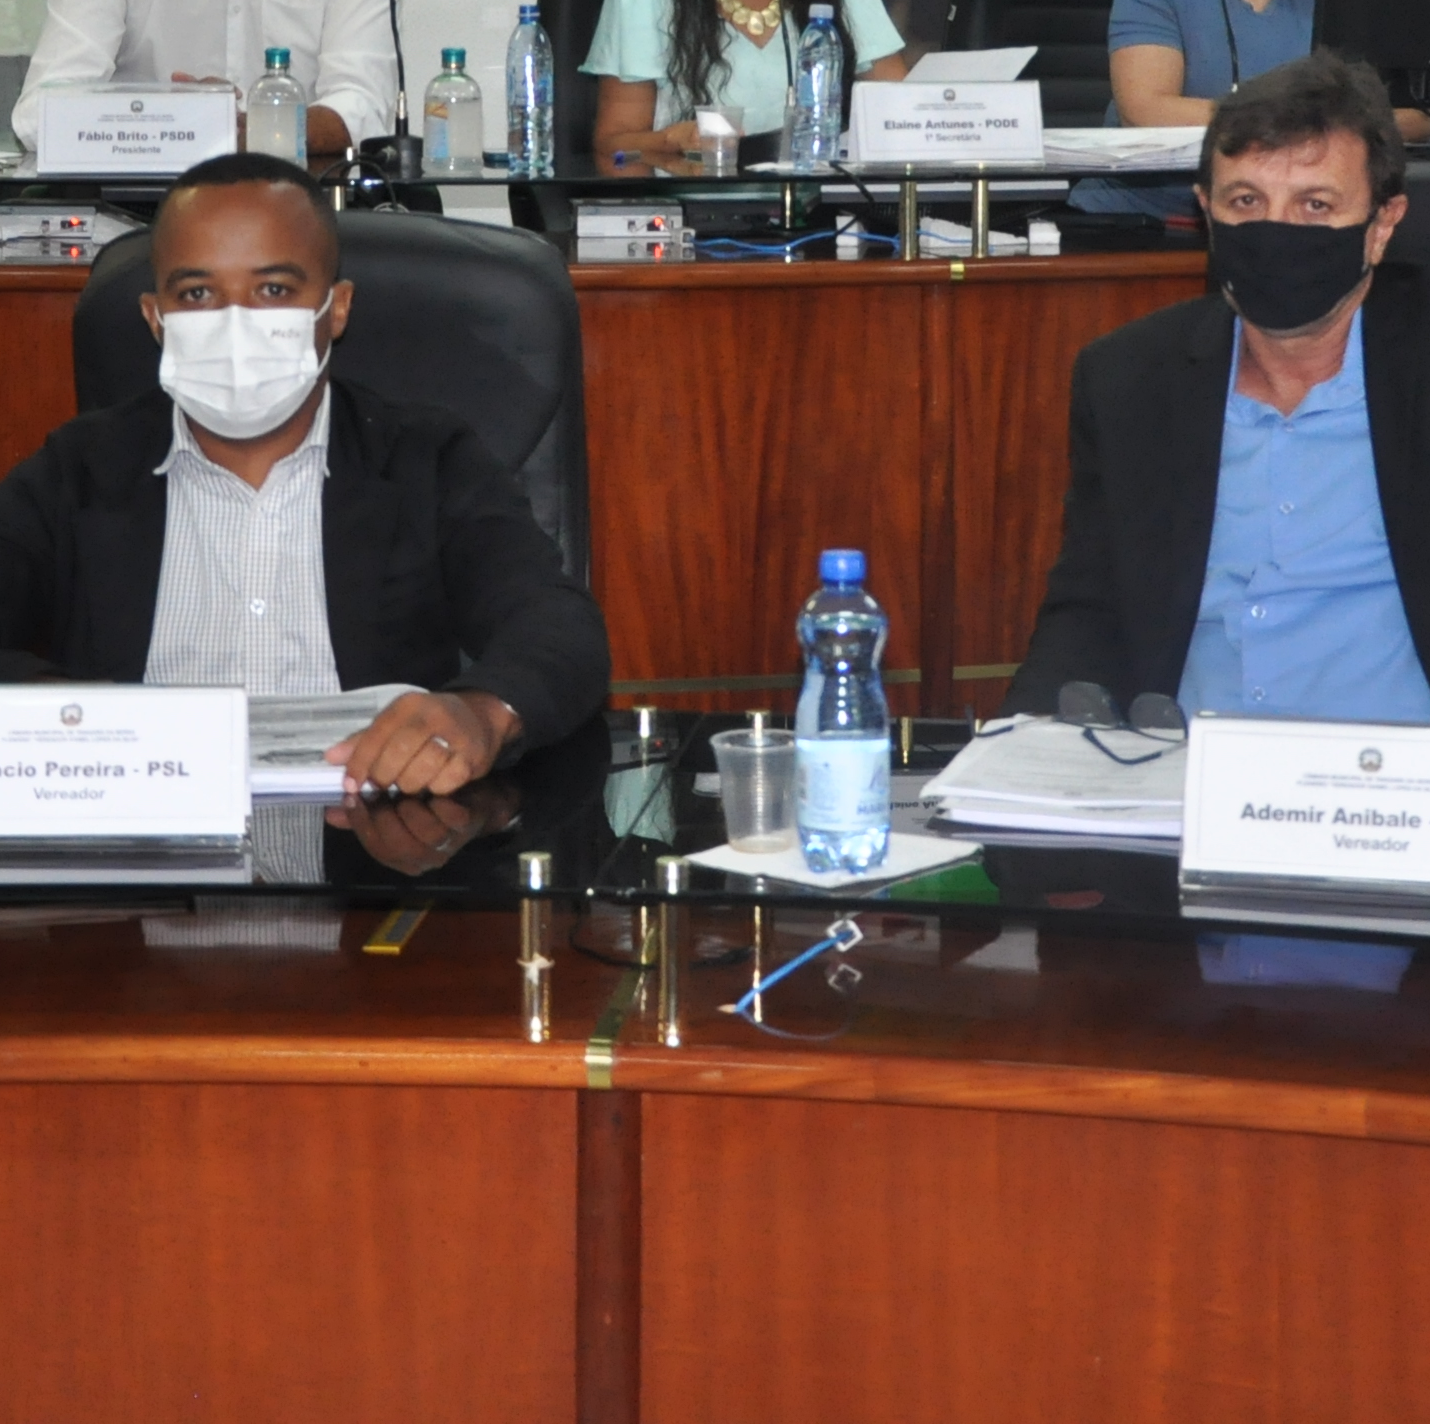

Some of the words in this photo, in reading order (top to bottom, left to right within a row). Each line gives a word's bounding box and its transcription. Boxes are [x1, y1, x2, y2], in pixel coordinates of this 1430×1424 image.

[884, 120, 921, 130] Elaine
[925, 120, 974, 130] Antunes
[985, 119, 1019, 129] PODE
[78, 130, 113, 141] Fábio
[117, 131, 148, 141] Brito
[160, 131, 196, 141] PSDB
[112, 145, 161, 155] Presidente
[45, 761, 125, 778] Pereira
[147, 760, 190, 777] PSL
[32, 786, 106, 802] Vereador
[1240, 802, 1326, 824] Ademir
[1331, 807, 1421, 829] Anibale
[1333, 833, 1410, 852] Vereador
